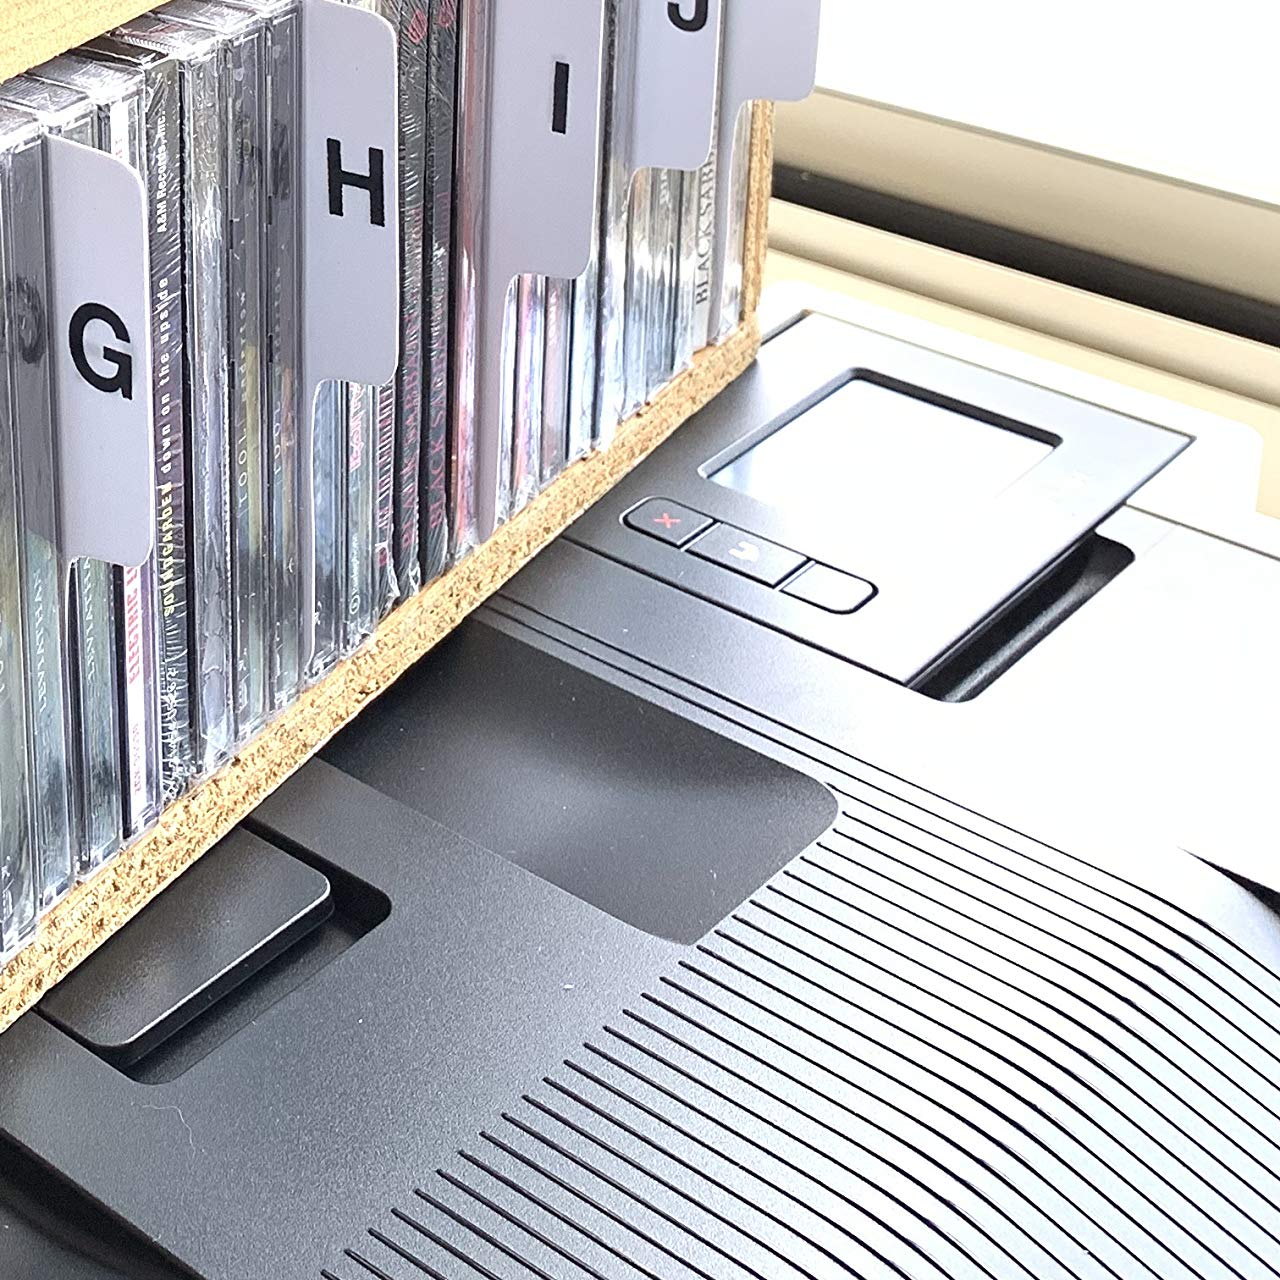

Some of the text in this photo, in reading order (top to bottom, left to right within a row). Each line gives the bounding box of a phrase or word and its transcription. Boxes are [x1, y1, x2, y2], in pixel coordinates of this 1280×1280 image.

[552, 62, 570, 135] I
[155, 202, 167, 233] A&M
[326, 138, 384, 227] H
[695, 221, 712, 306] BLACK
[69, 302, 133, 401] G
[154, 278, 171, 344] upside
[157, 353, 170, 386] the
[159, 392, 172, 415] on
[158, 424, 172, 474] down
[237, 429, 248, 508] TOOL
[428, 435, 445, 529] BLACK
[160, 483, 176, 617] SOUNDGARDEN
[31, 568, 48, 713] LEVIATHAN
[82, 559, 96, 682] LEVIATHA
[124, 590, 140, 685] ELECTRIC
